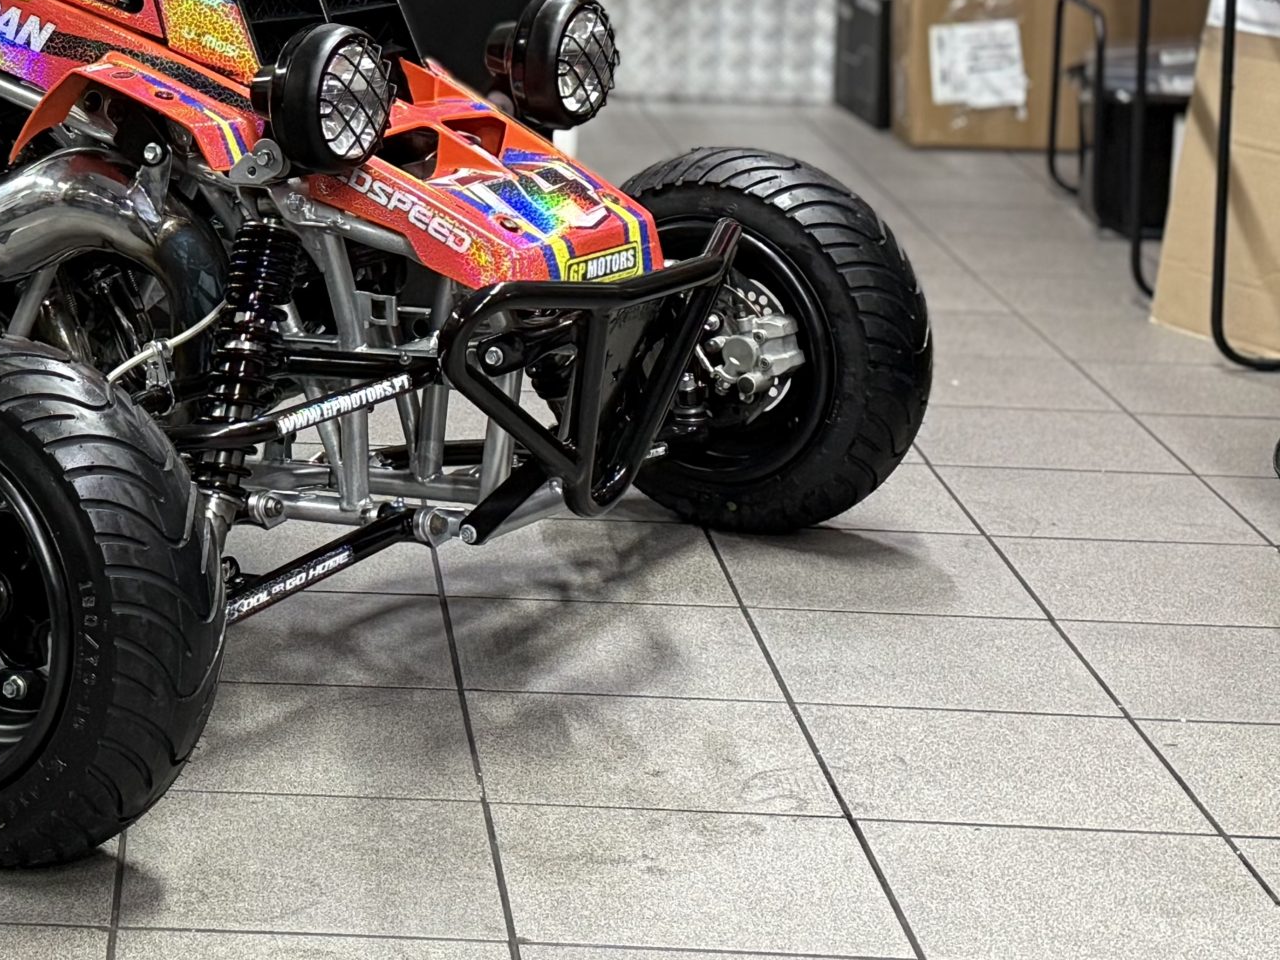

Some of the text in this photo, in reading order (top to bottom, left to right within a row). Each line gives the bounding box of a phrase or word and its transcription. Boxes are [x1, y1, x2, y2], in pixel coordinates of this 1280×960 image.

[337, 167, 472, 254] DSPEED
[570, 264, 587, 281] GP
[586, 249, 635, 280] MOTORS
[278, 374, 410, 435] WWW.GPMOTORS.PT
[272, 583, 285, 594] OR
[286, 572, 307, 591] GO
[308, 550, 350, 580] HOME
